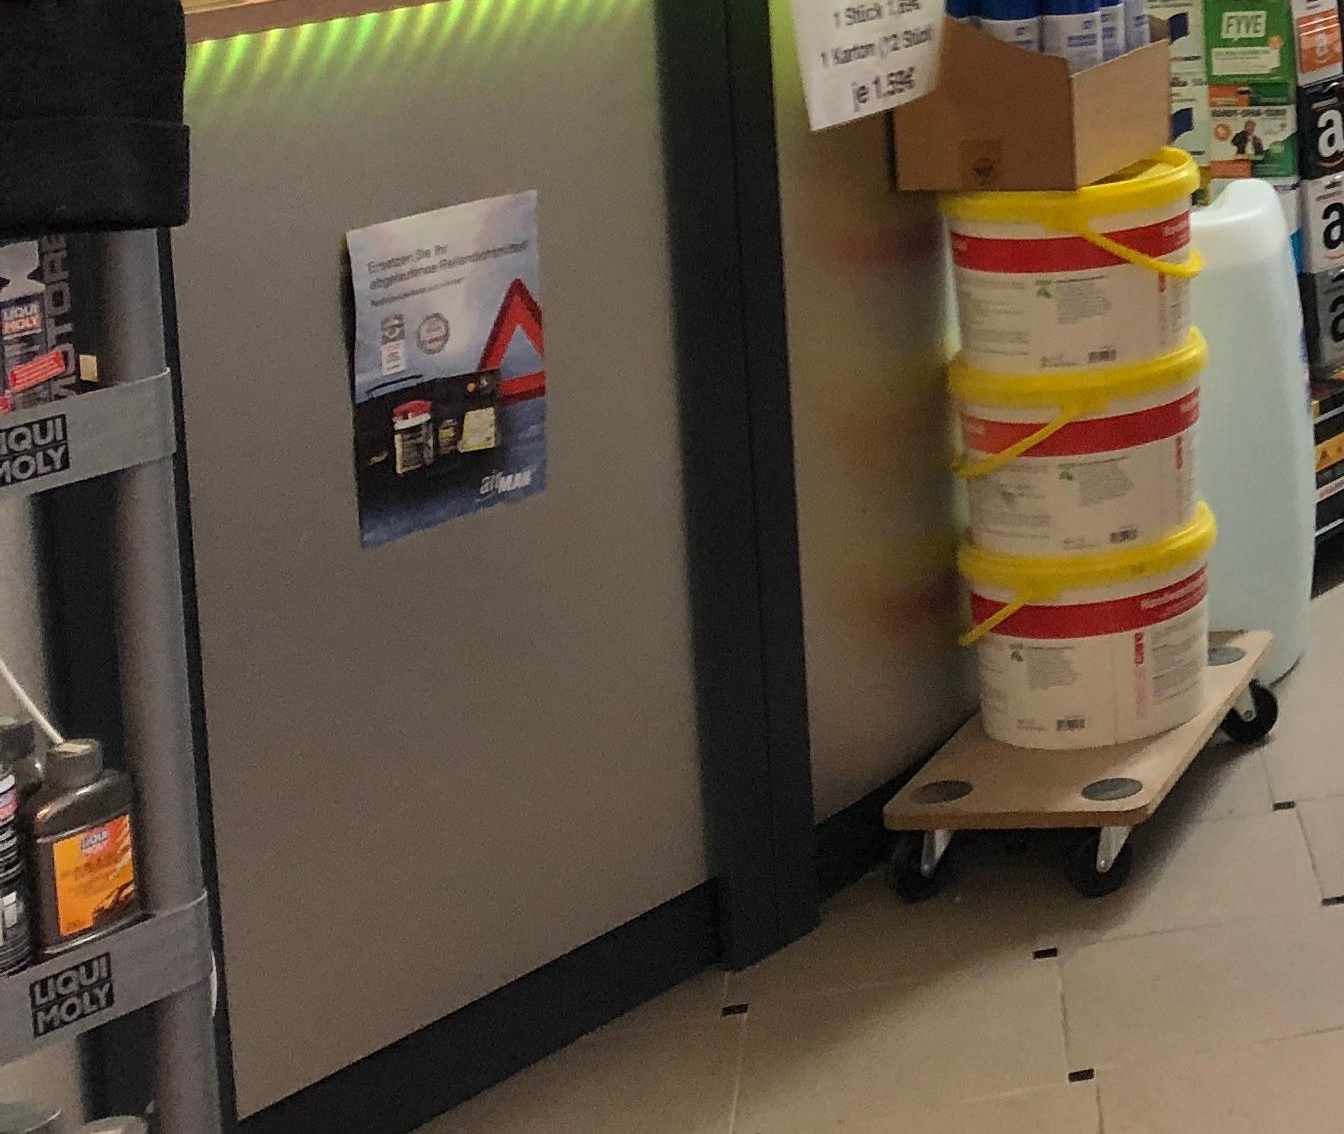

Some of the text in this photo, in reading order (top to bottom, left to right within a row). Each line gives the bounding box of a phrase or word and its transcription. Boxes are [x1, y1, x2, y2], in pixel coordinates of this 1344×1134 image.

[833, 2, 882, 27] 1 Stück
[1224, 16, 1264, 35] FYVE
[820, 52, 828, 66] 1
[833, 42, 876, 66] Karton
[852, 81, 869, 112] je
[367, 244, 448, 275] Ersetzen Sie Ihr
[0, 418, 65, 452] IQUI
[34, 954, 109, 1005] LIQUI
[36, 982, 112, 1036] MOLY
